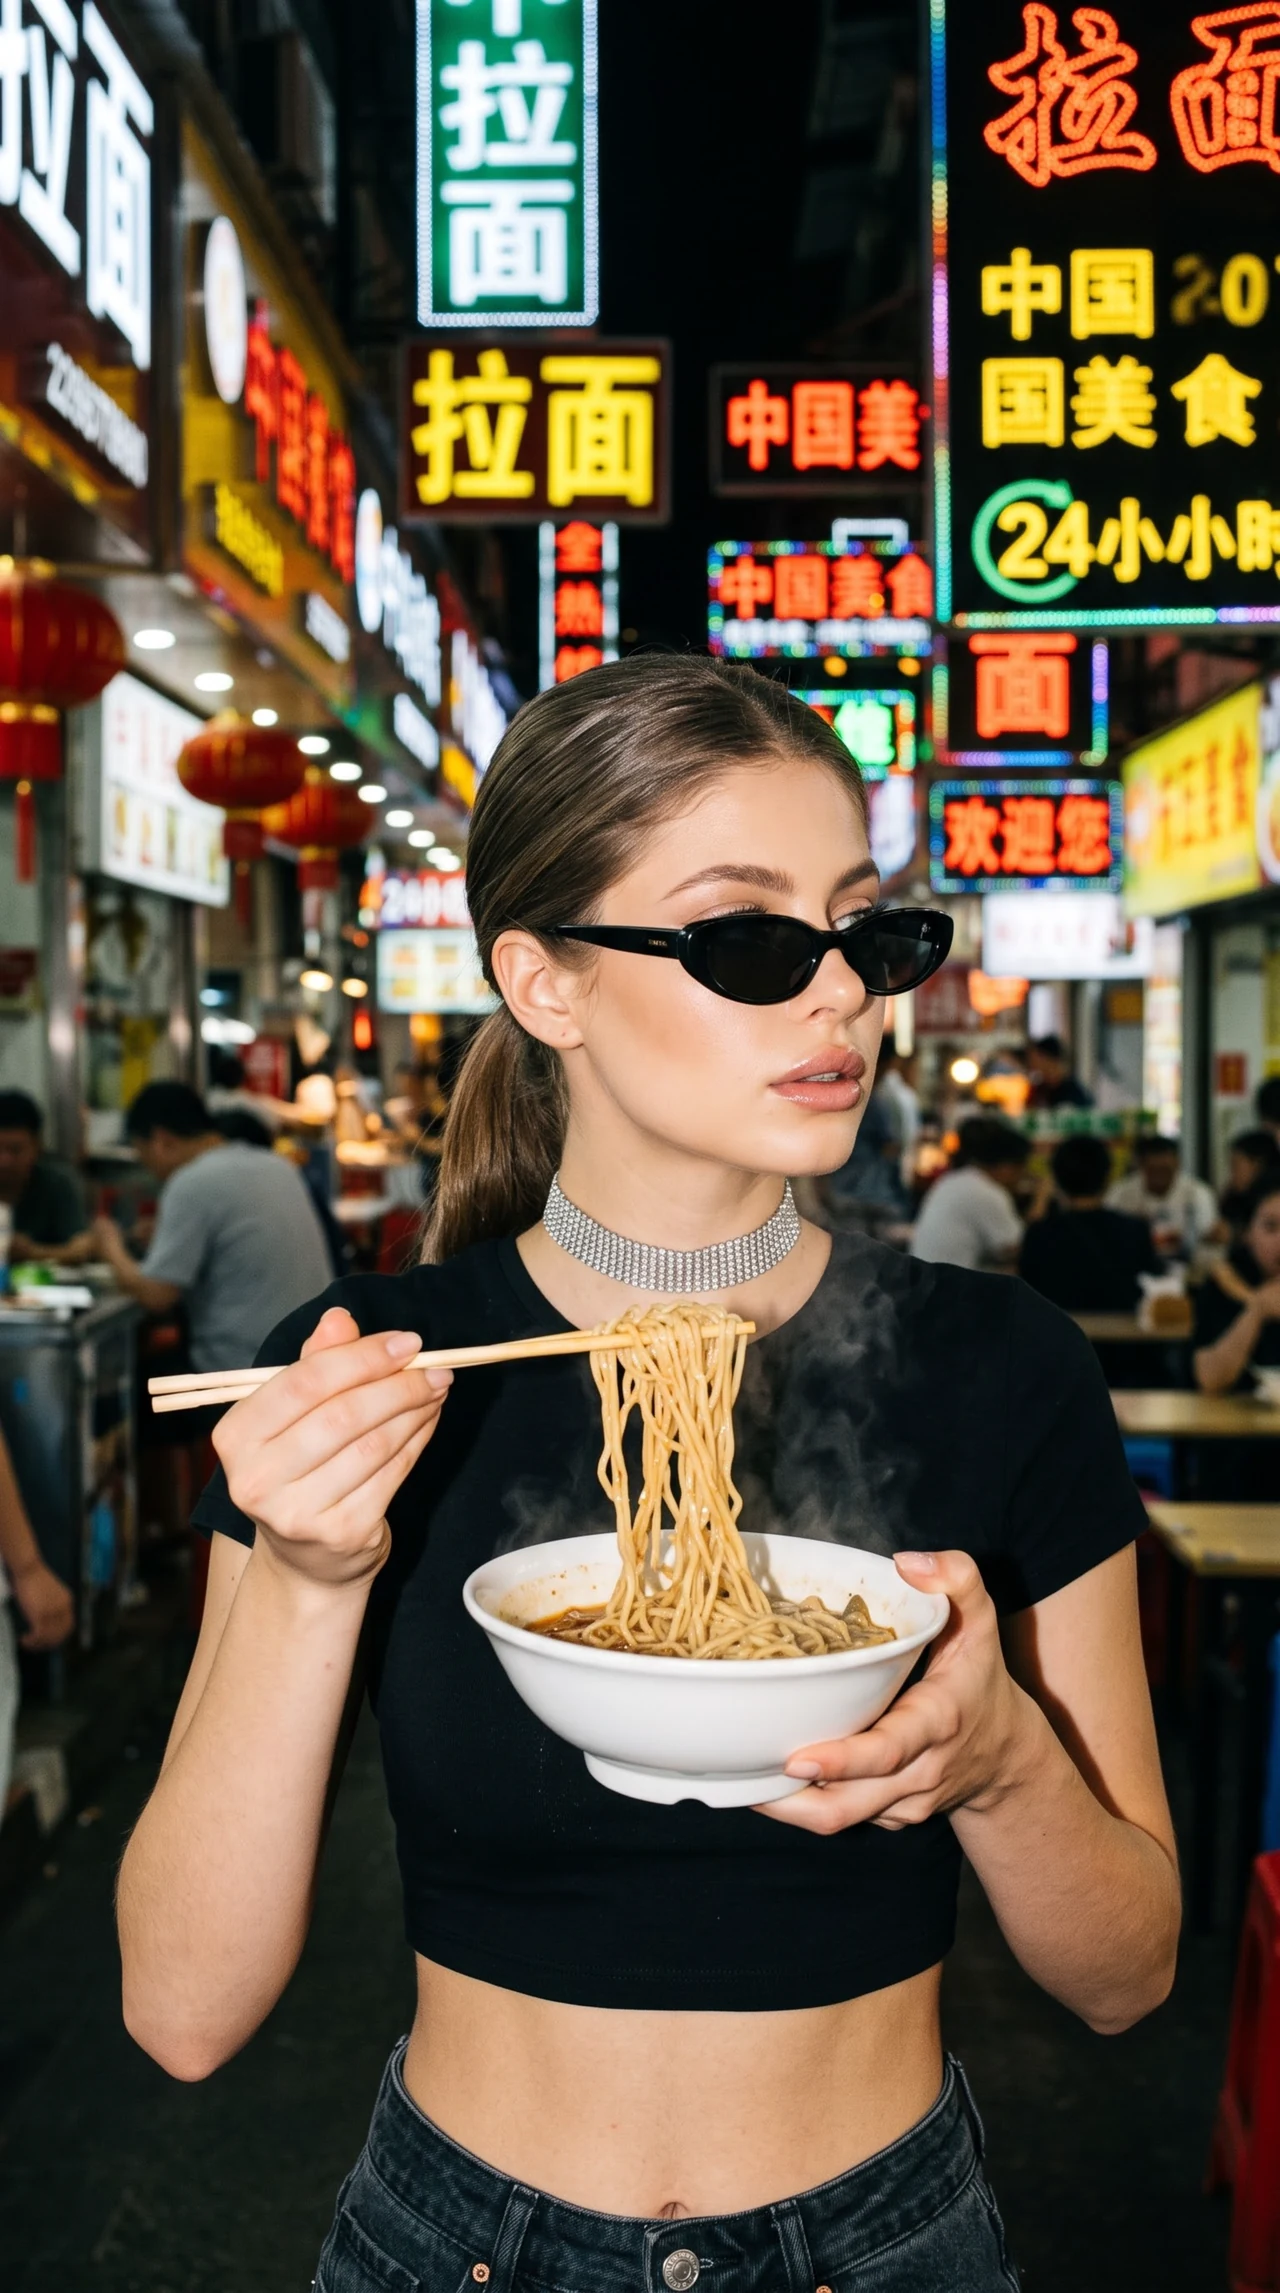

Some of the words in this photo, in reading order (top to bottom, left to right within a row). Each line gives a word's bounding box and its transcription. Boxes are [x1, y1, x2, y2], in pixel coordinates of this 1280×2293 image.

[984, 2, 1280, 187] 拉面
[437, 0, 578, 306] 拉面
[412, 349, 662, 507] 拉面
[727, 379, 931, 471] 中国美
[981, 353, 1263, 449] 国美食
[718, 553, 932, 621] 中国美食
[968, 633, 1078, 739] 面
[943, 795, 1113, 875] 欢迎您
